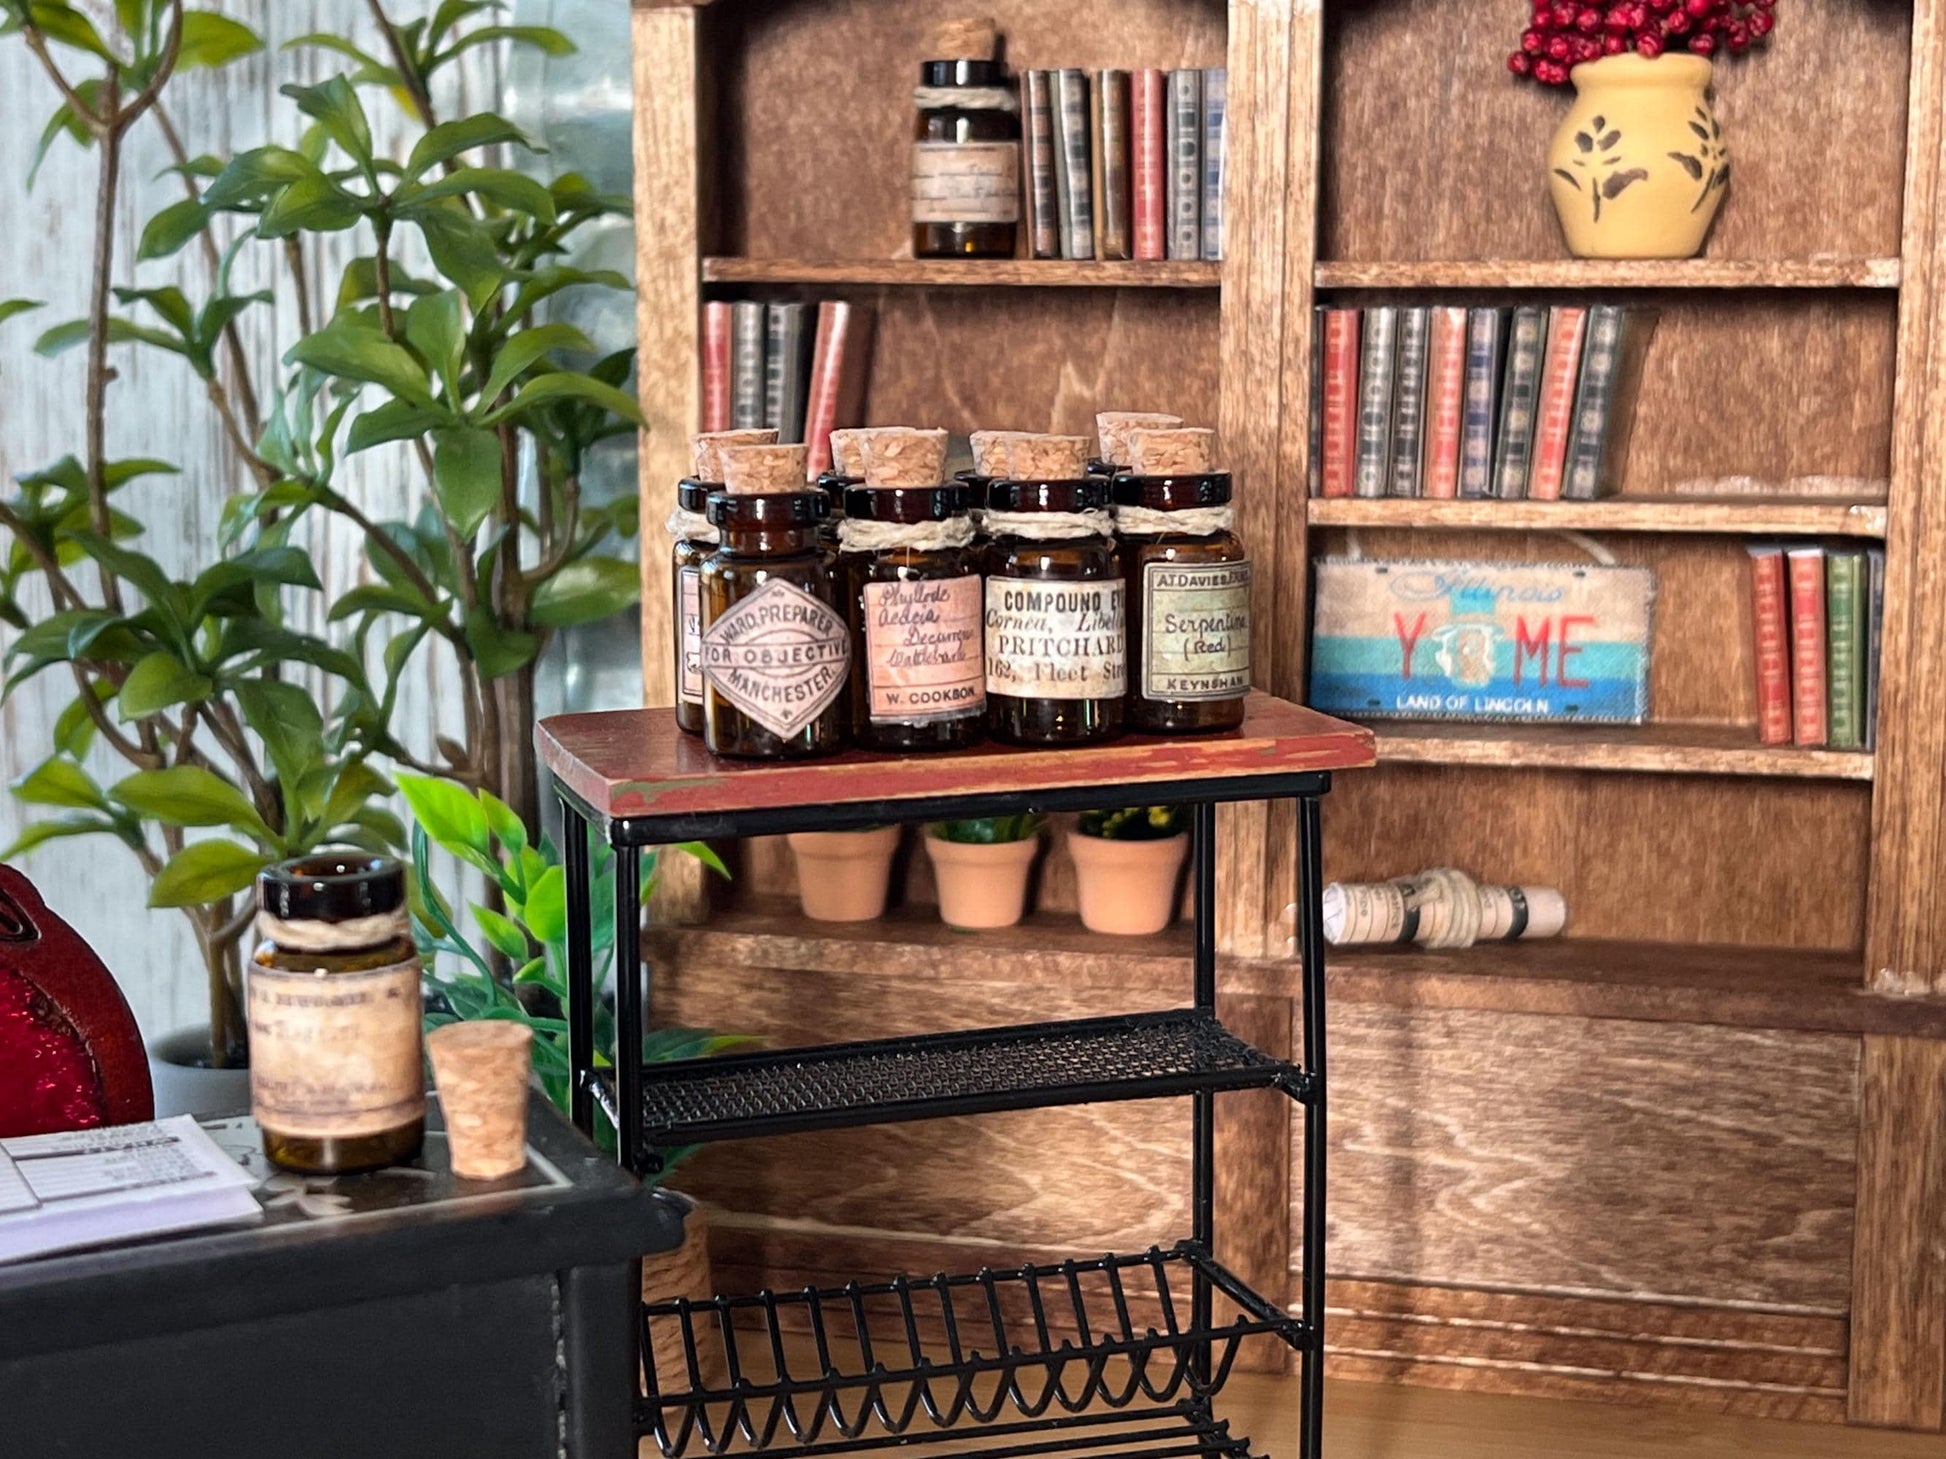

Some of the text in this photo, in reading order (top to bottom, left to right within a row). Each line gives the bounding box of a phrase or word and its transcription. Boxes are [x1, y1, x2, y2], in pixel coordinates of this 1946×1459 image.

[1005, 590, 1101, 613] COMPOUND
[759, 604, 833, 637] PREPARER
[705, 646, 731, 663] FOR
[999, 634, 1124, 658] PRITCHARD
[1184, 635, 1231, 661] (Red)
[1396, 694, 1550, 713] LAND OF LINCOLN
